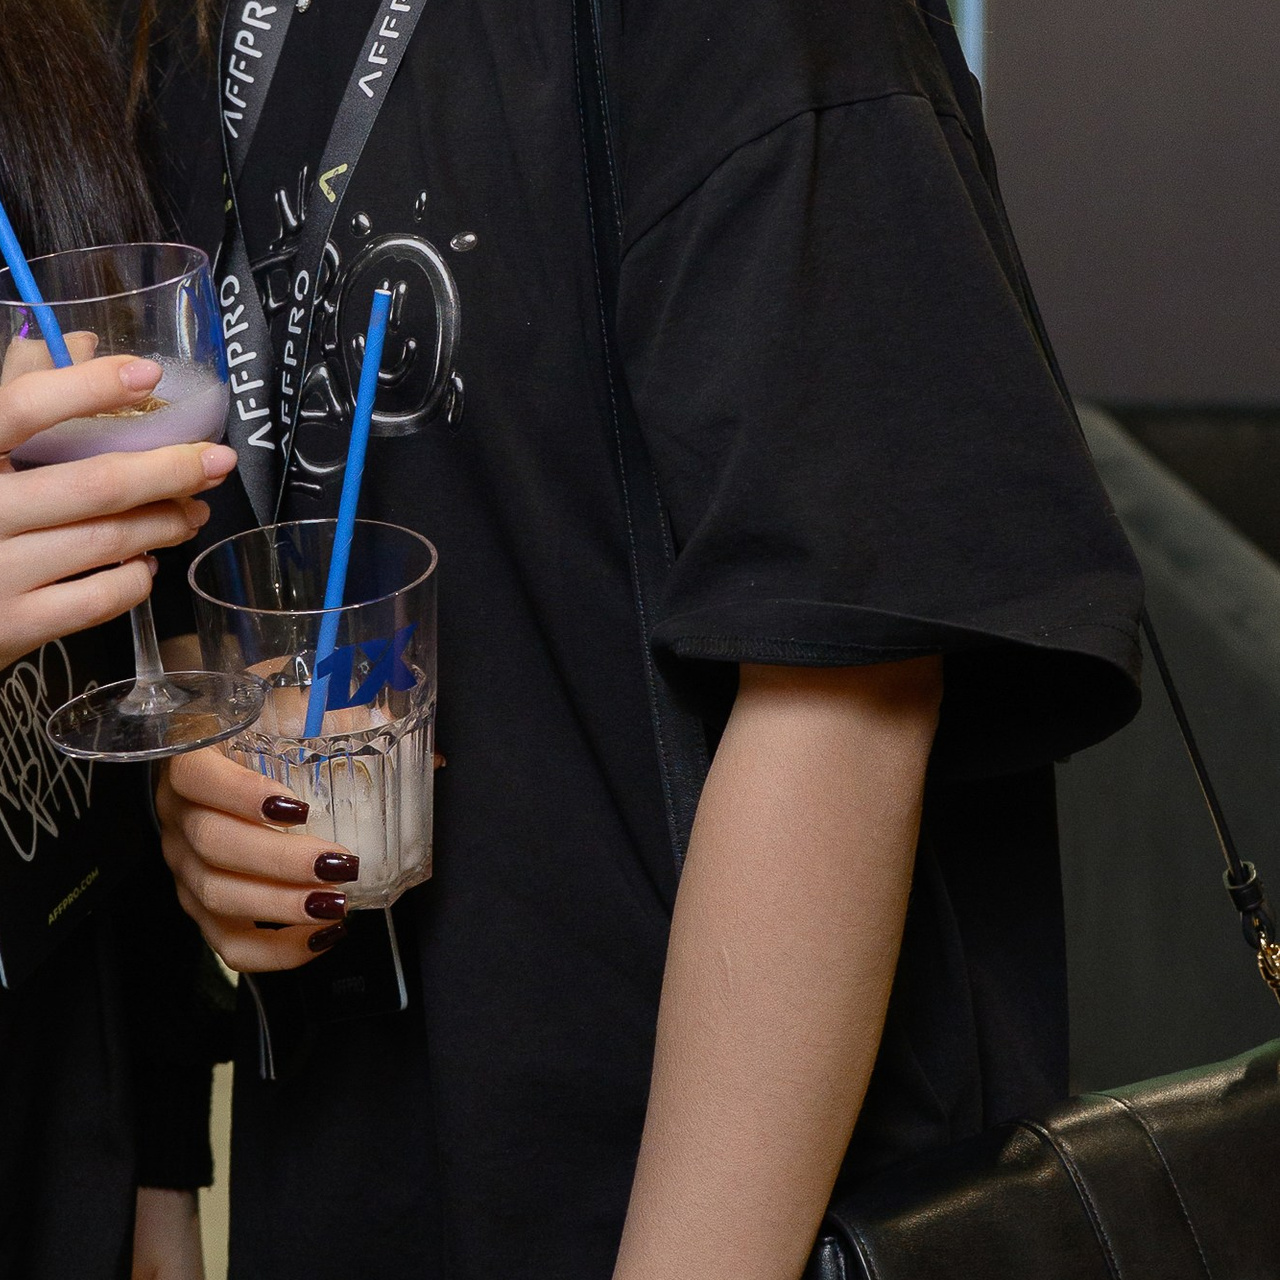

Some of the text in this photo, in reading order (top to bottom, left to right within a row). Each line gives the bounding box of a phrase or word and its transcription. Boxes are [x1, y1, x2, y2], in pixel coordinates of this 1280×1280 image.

[221, 274, 276, 450] AFFPRO
[281, 269, 310, 459] AFFPRO
[47, 867, 100, 926] AFFPRO.COM
